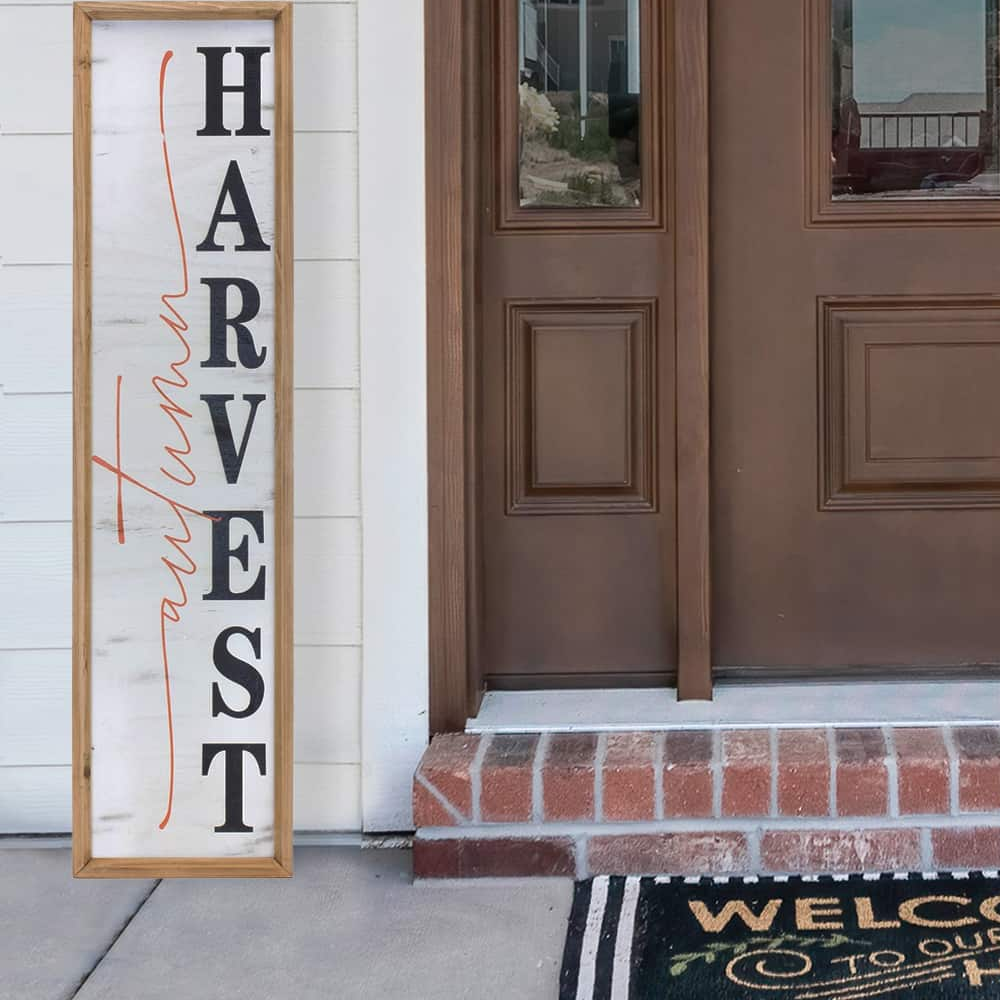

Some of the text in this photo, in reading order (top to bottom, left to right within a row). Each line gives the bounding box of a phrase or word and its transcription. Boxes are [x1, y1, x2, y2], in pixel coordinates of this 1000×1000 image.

[92, 50, 222, 830] autumn
[196, 46, 271, 833] HARVEST
[831, 949, 905, 974] TO
